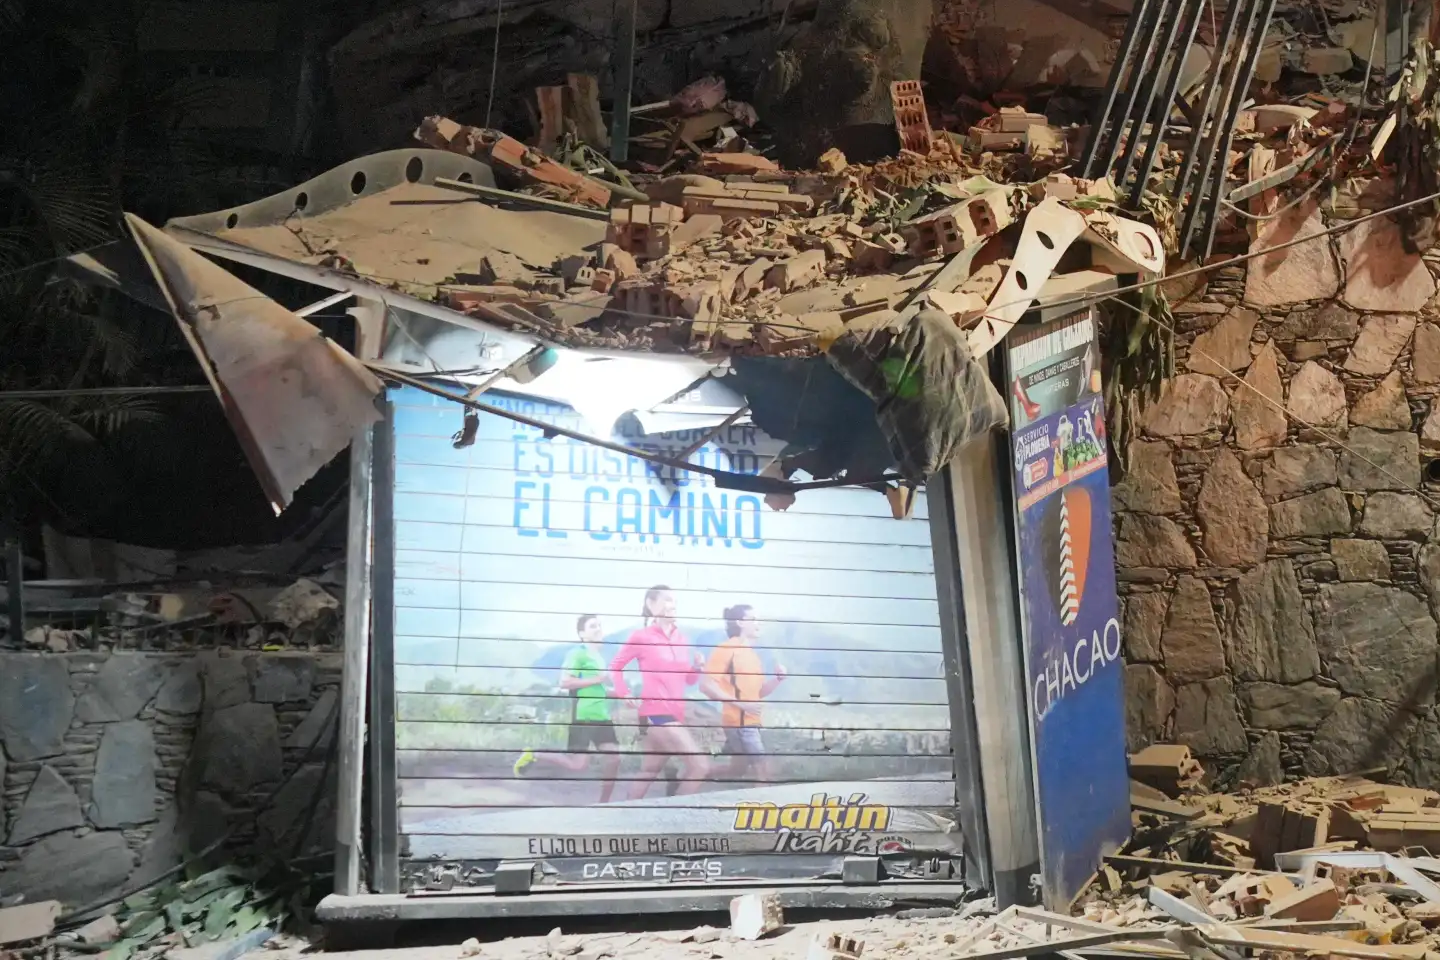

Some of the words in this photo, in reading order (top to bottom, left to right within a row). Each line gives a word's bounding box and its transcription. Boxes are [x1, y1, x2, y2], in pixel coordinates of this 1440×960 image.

[1023, 423, 1049, 444] SERVICIO
[511, 433, 554, 479] ES
[512, 480, 568, 538] EL
[583, 485, 766, 550] CAMINO
[1033, 617, 1121, 722] CHACAO
[733, 792, 892, 832] maltín
[528, 837, 577, 854] ELIJO
[583, 838, 602, 854] LO
[609, 837, 641, 854] QUE
[647, 837, 670, 853] ME
[676, 837, 730, 853] GUSTA
